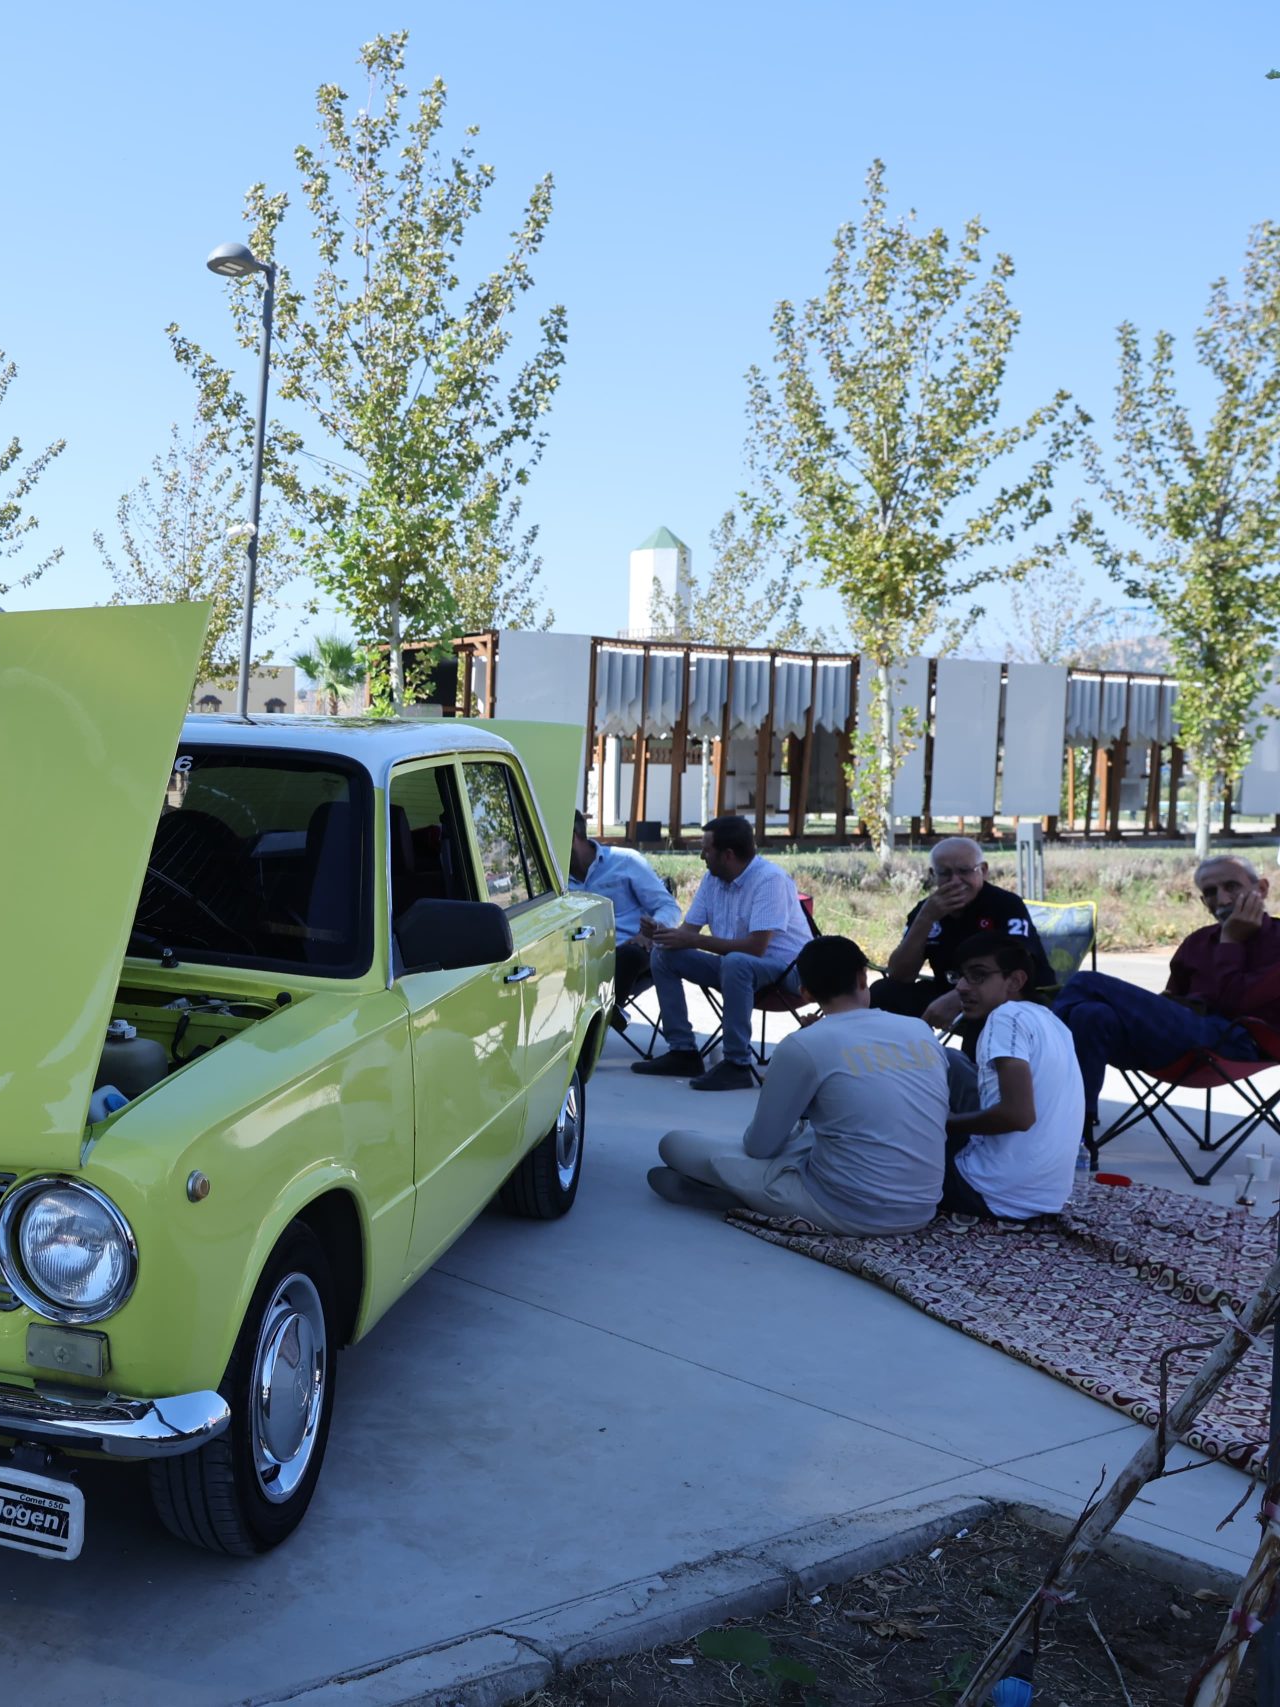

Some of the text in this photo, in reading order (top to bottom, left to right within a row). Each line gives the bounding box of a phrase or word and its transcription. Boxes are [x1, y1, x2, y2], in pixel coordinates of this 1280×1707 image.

[1007, 918, 1029, 938] 21
[19, 1493, 64, 1511] Comet 550
